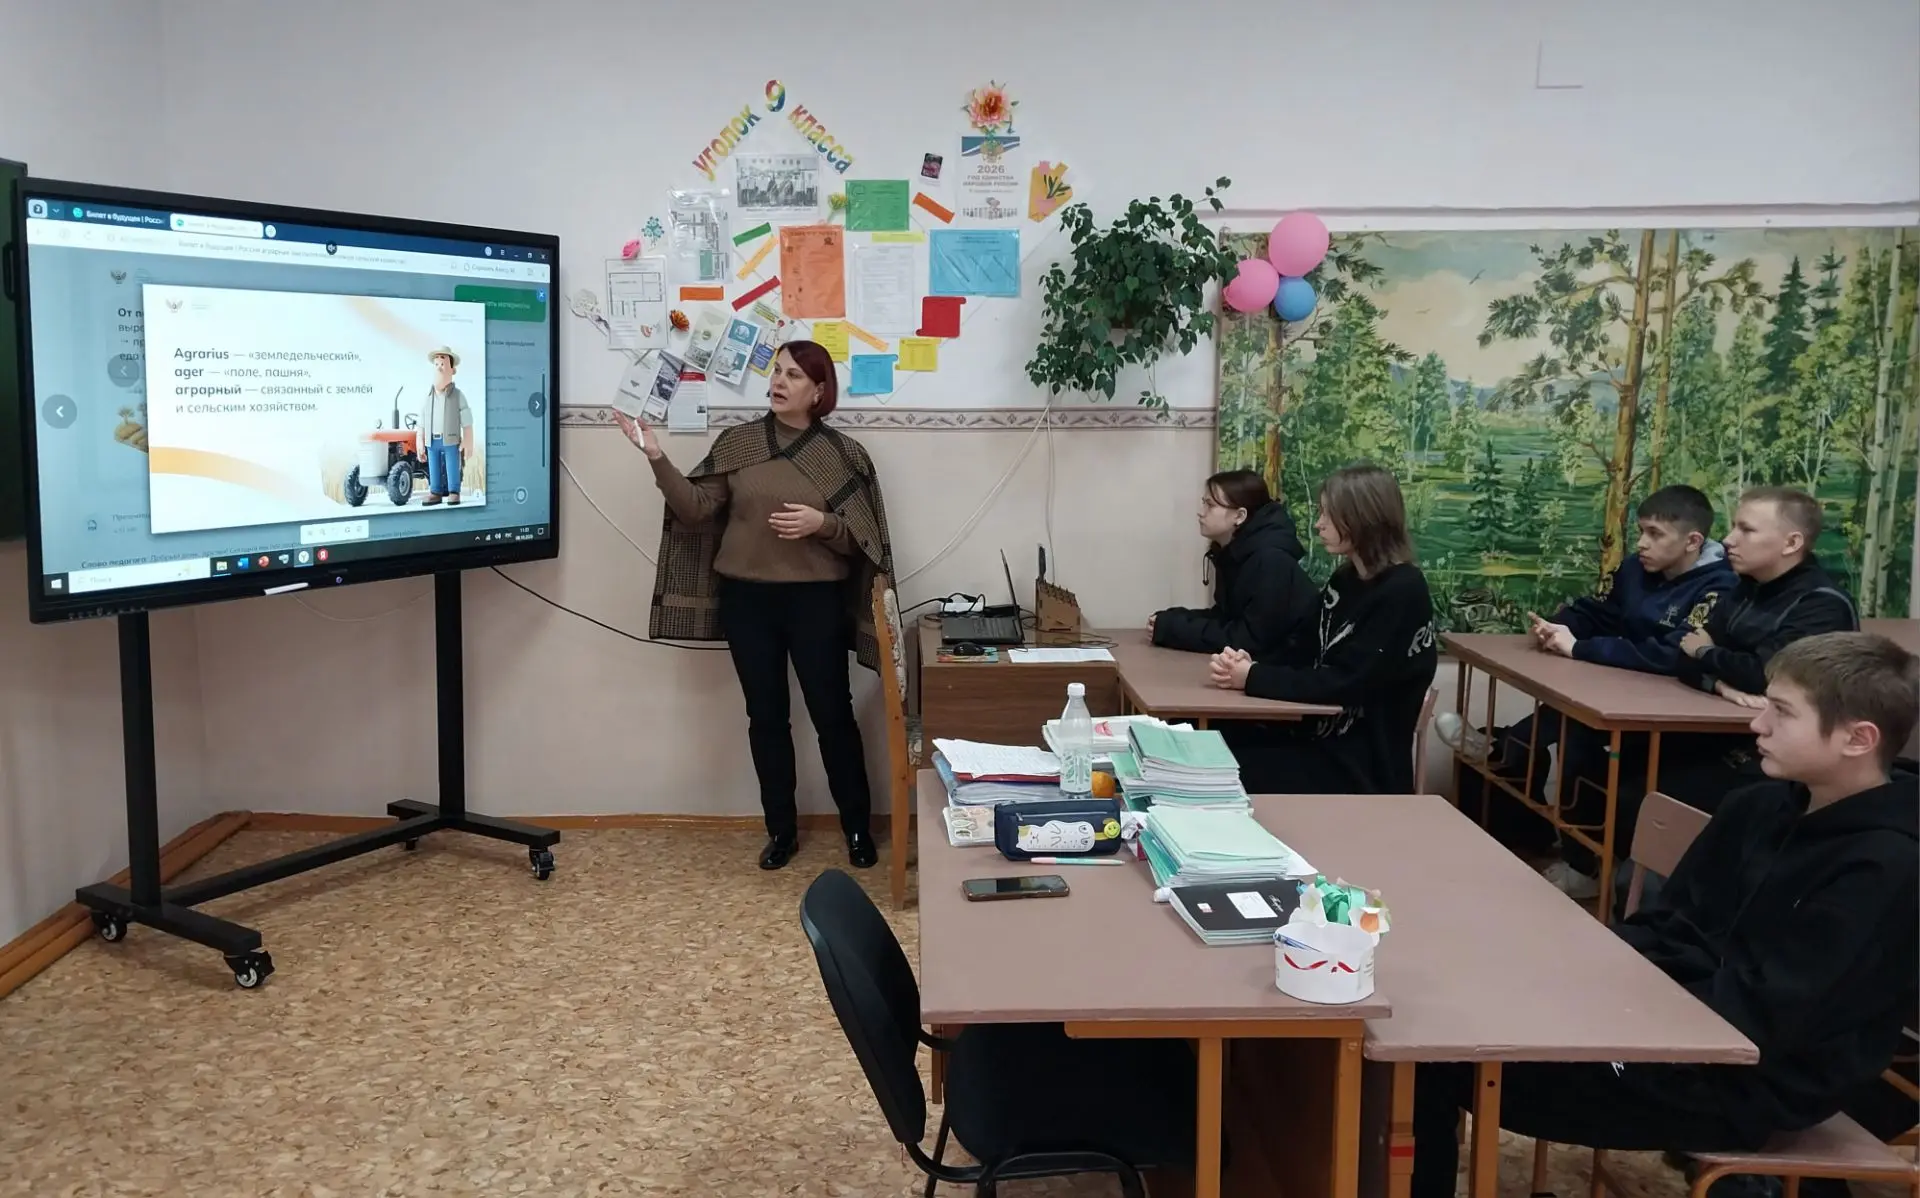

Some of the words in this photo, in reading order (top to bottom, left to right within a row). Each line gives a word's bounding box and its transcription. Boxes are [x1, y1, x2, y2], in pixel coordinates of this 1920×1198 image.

[765, 79, 785, 112] 9
[692, 104, 762, 182] уголок
[788, 104, 856, 175] класса
[976, 165, 1005, 174] 2026
[118, 308, 132, 318] От
[174, 347, 230, 362] Agrarius
[249, 350, 362, 362] «земледельческий»,
[174, 367, 204, 379] ager
[224, 367, 263, 378] «поле,
[265, 367, 311, 379] пашня»,
[175, 383, 242, 398] аграрный
[260, 383, 324, 395] связанный
[326, 385, 333, 394] с
[335, 382, 373, 395] землёй
[176, 404, 184, 413] и
[187, 402, 246, 414] сельским
[249, 401, 319, 413] хозяйством.
